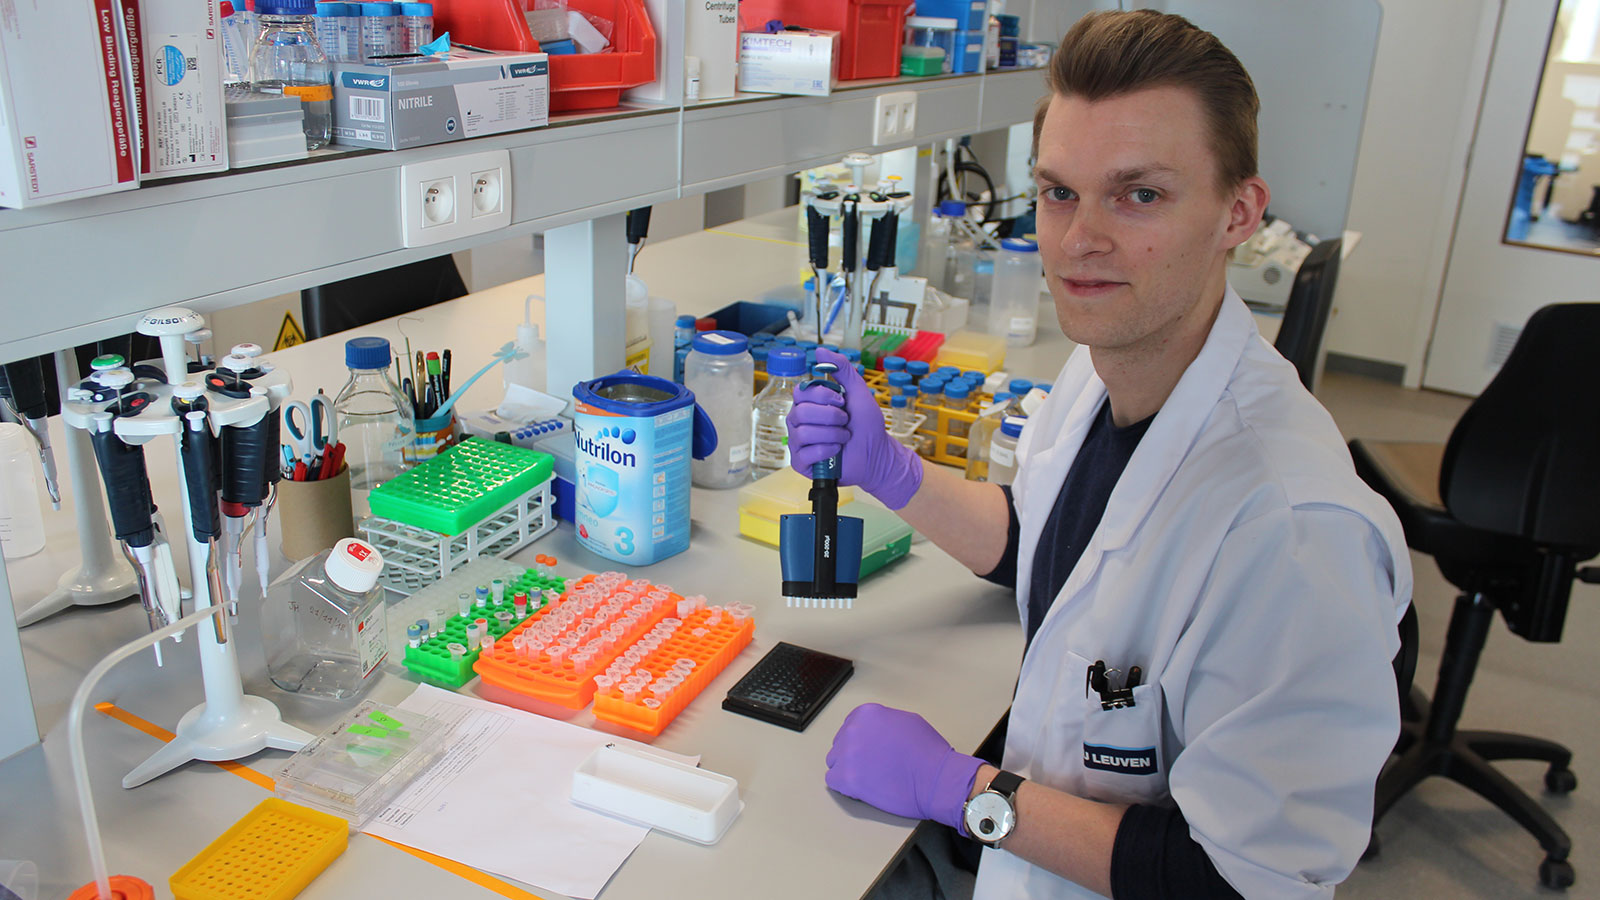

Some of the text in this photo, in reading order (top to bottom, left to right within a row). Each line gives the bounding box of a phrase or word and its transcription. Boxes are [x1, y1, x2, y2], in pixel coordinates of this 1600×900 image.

[706, 1, 736, 12] Centrifuge
[719, 14, 736, 24] Tubes
[742, 37, 792, 48] KIMTECH
[101, 9, 128, 158] Low Binding Reagiergefäße
[398, 96, 432, 110] NITRILE
[26, 152, 40, 194] SARSTEDT
[574, 430, 636, 467] Nutrilon
[614, 526, 635, 556] 3
[1092, 753, 1151, 767] LEUVEN
